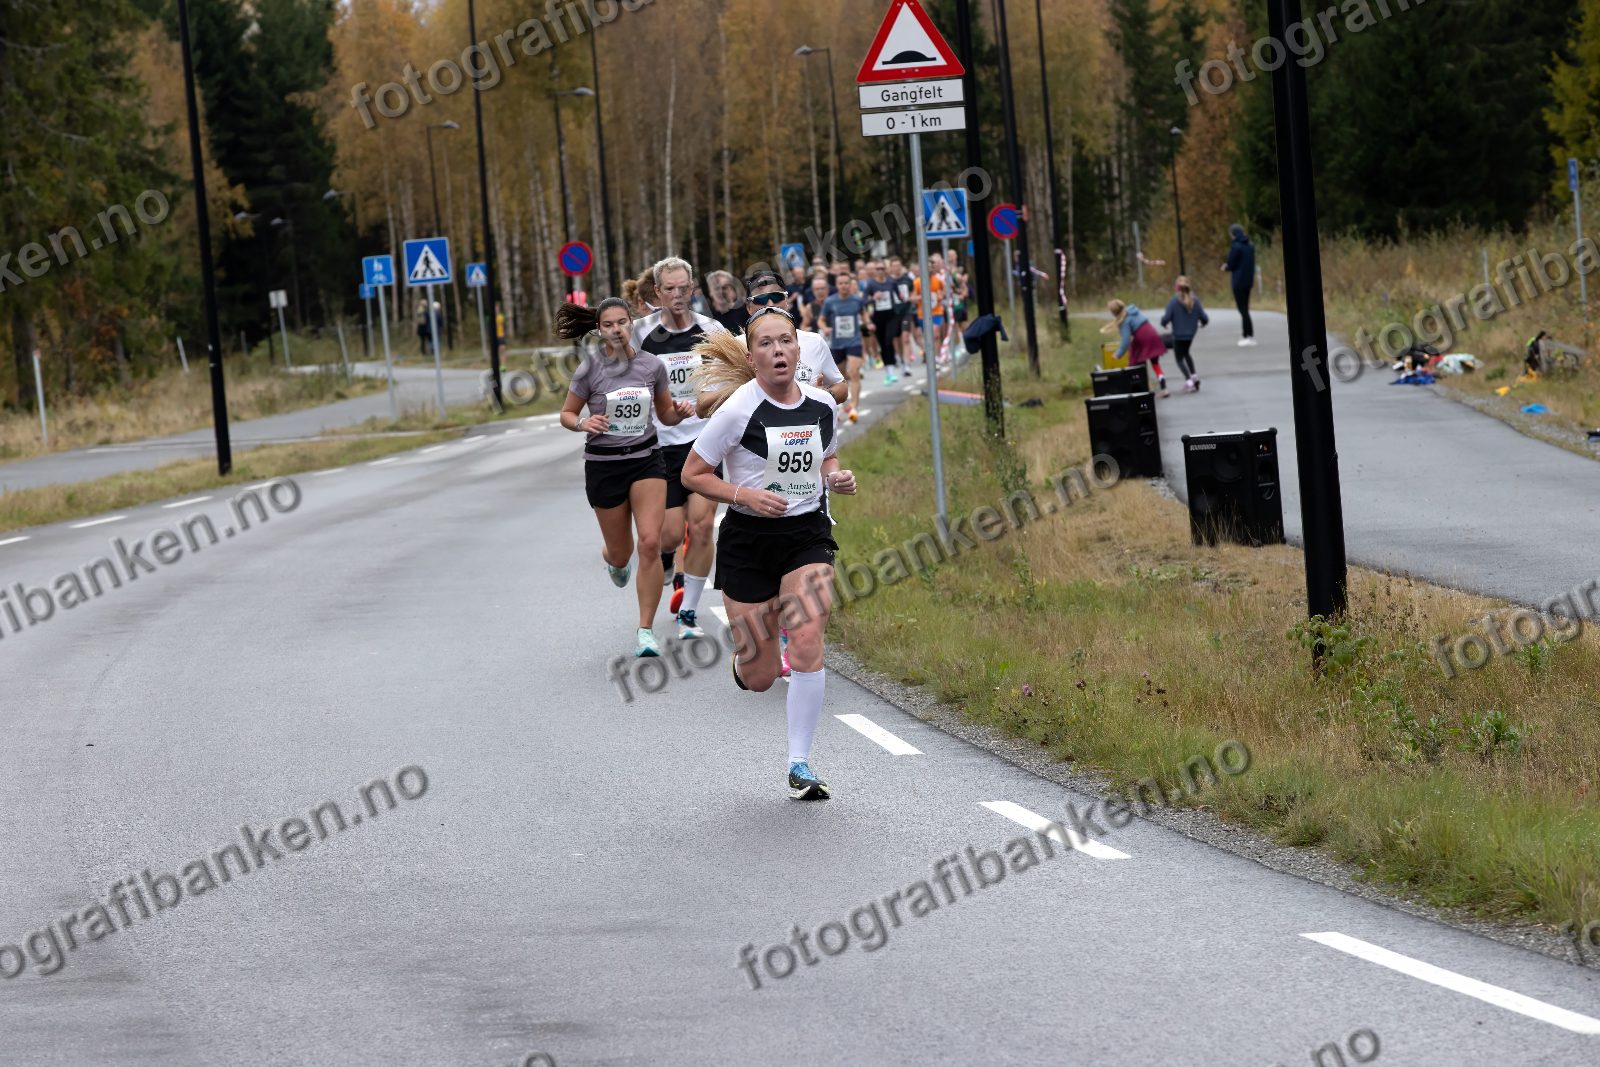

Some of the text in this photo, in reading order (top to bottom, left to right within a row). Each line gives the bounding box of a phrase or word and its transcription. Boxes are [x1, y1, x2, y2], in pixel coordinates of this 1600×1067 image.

[881, 85, 943, 103] Gangfelt
[886, 117, 896, 130] 0
[920, 114, 942, 127] km
[614, 403, 642, 418] 539
[780, 430, 813, 439] NORGES
[784, 438, 810, 446] LØPET
[777, 450, 813, 473] 959
